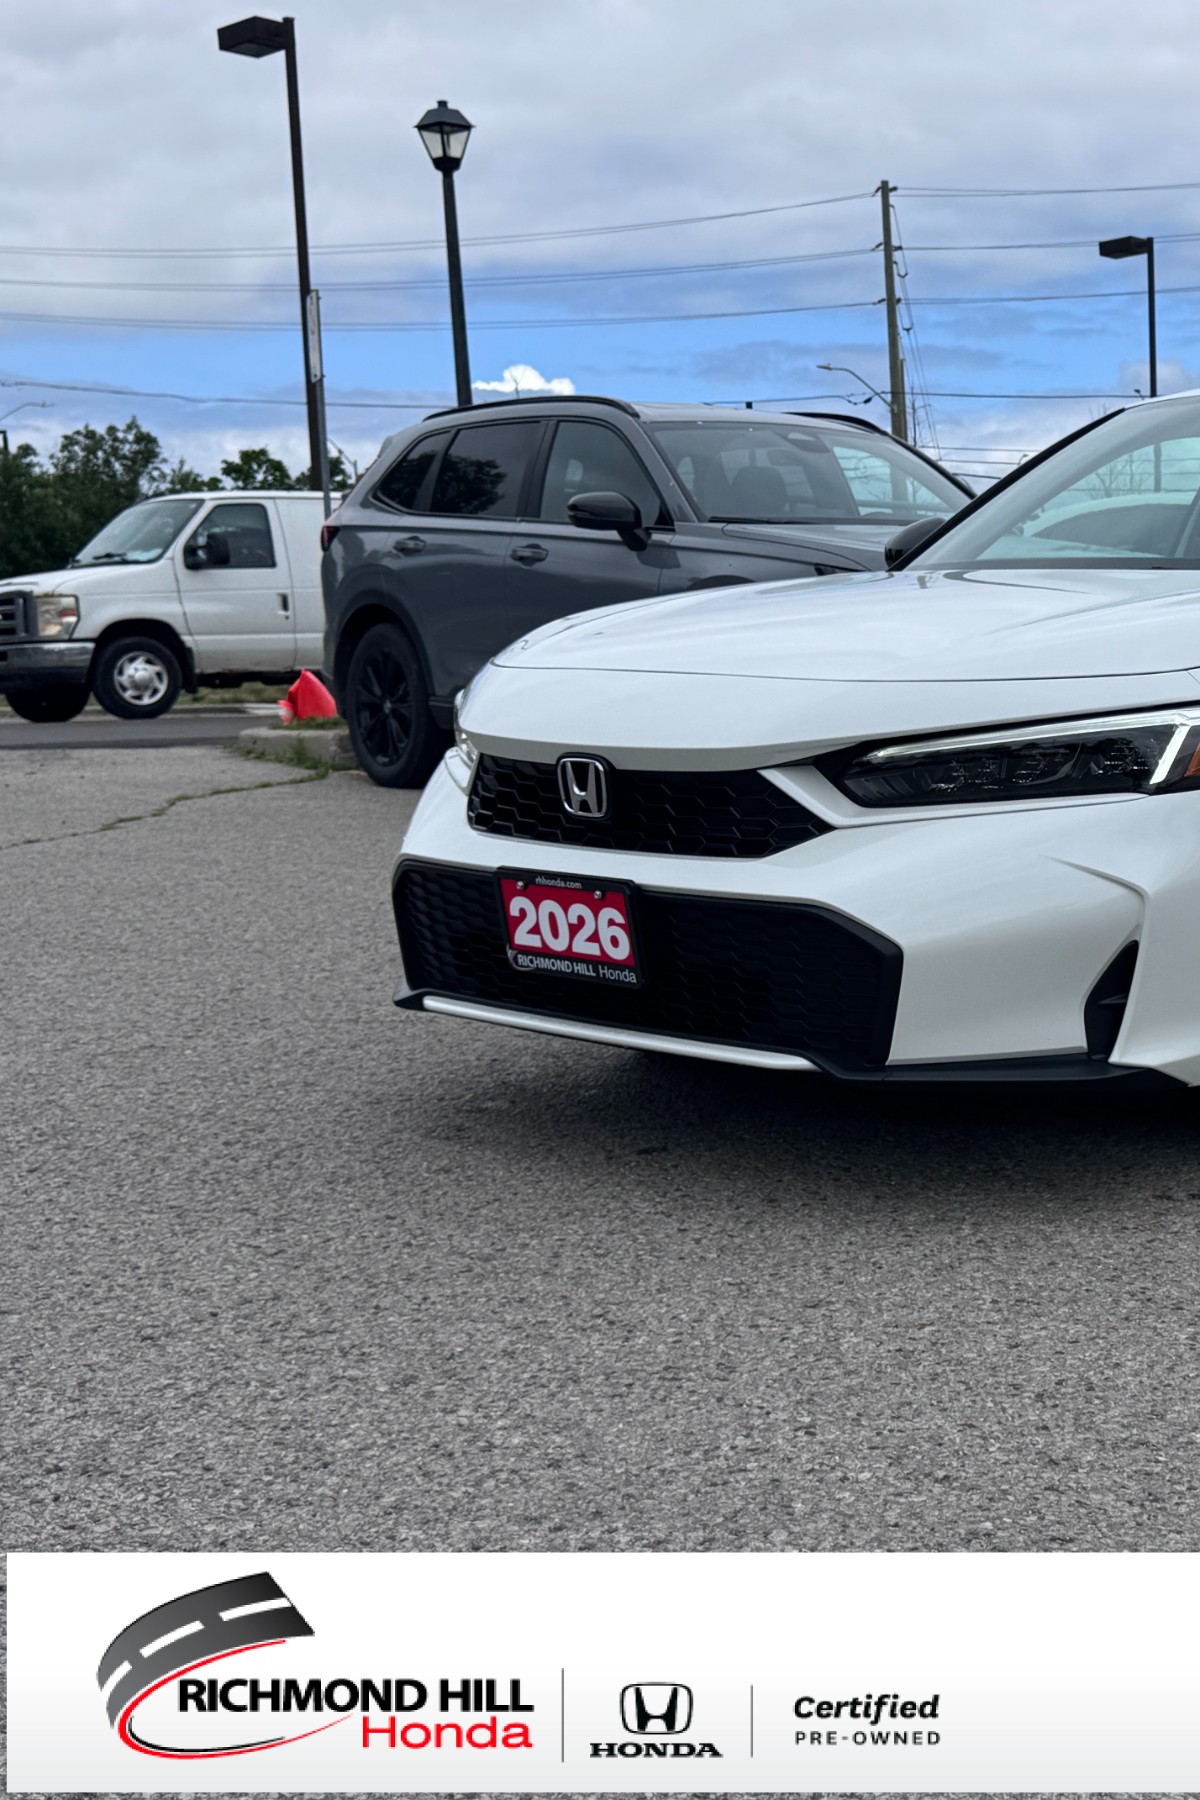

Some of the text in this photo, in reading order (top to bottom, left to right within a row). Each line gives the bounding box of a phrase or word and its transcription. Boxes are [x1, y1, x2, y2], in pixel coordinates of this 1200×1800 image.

[535, 876, 582, 890] rhhonda.com
[509, 895, 631, 961] 2026
[517, 953, 637, 984] RICHMOND HILL Honda
